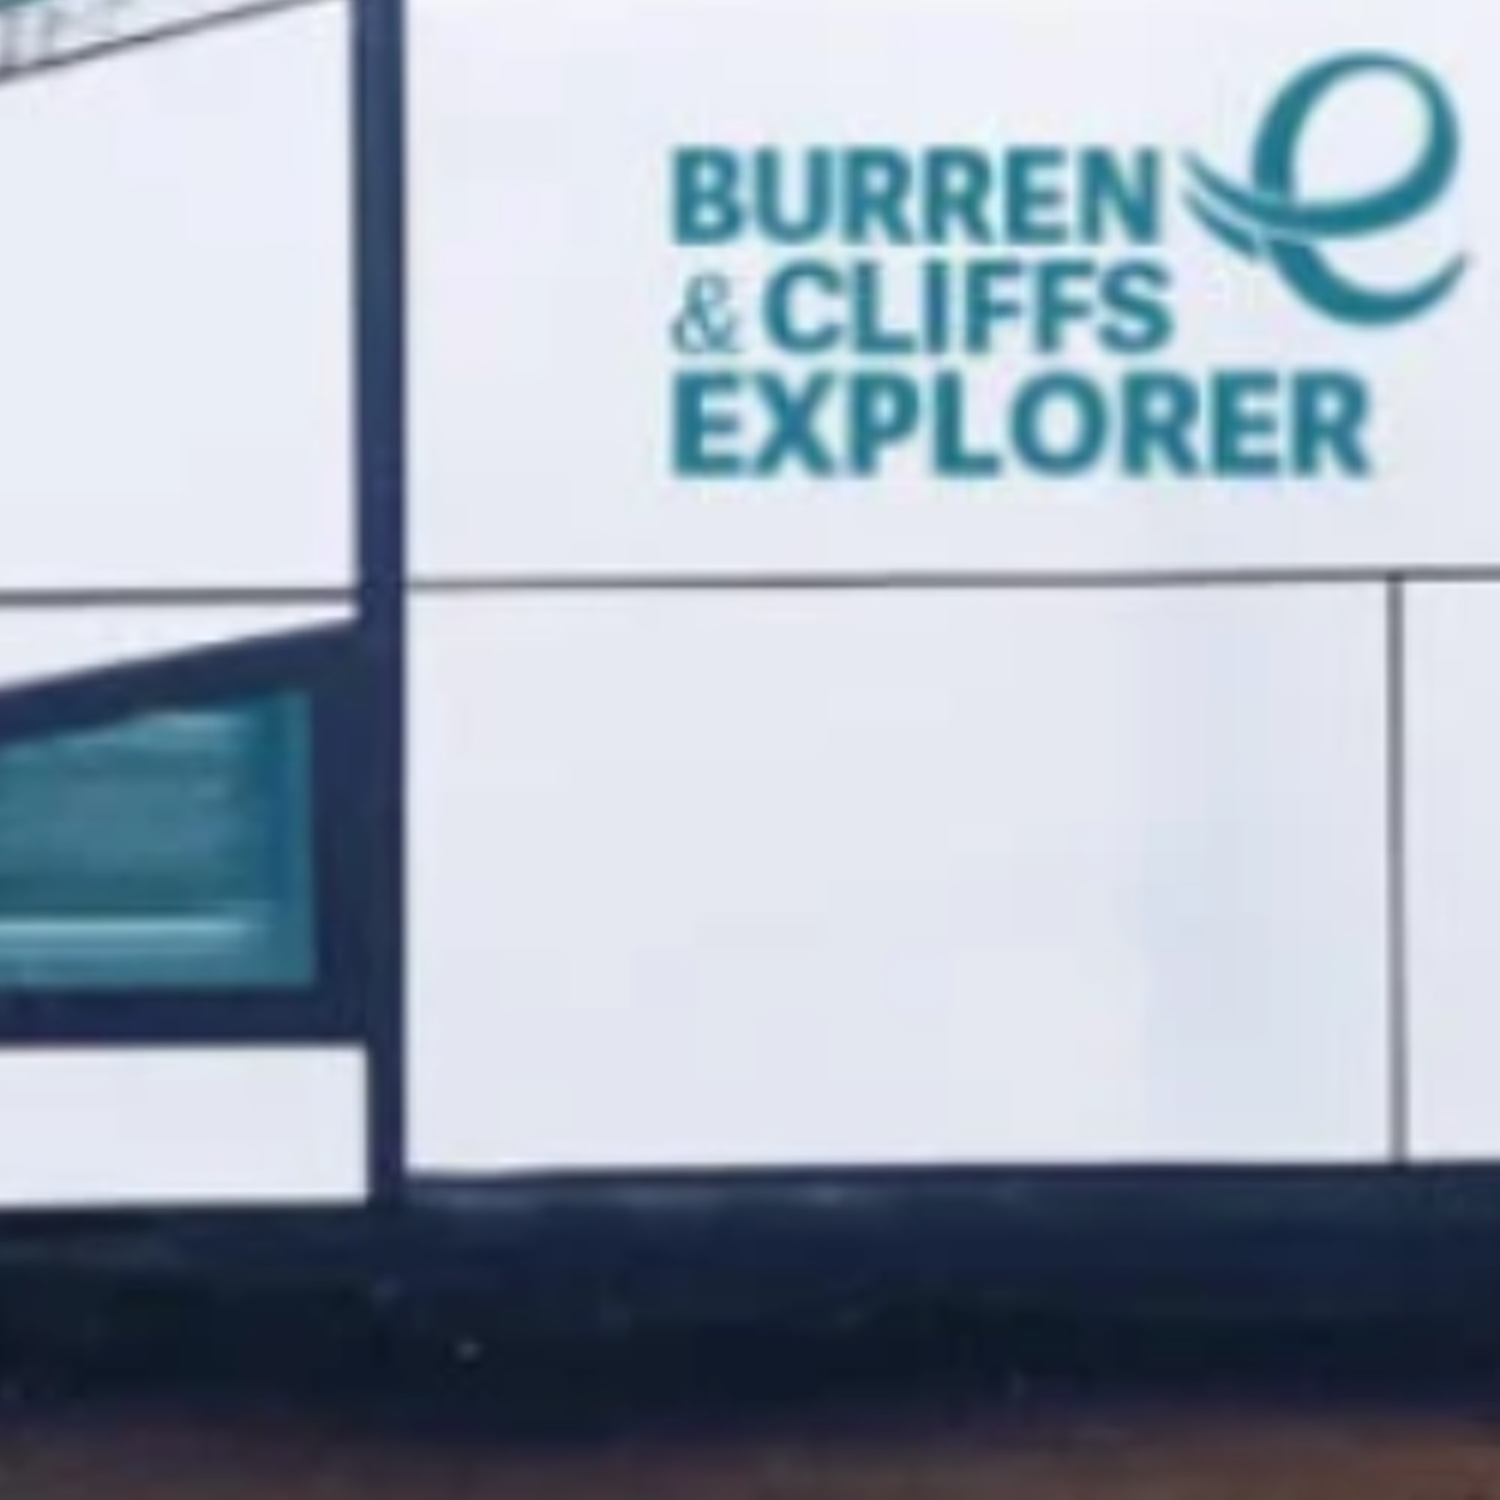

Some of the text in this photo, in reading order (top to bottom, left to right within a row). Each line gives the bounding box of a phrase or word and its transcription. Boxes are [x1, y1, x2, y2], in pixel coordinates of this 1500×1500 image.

[671, 145, 1162, 247] BURREN
[671, 257, 1175, 356] & CLIFFS
[671, 368, 1371, 479] EXPLORER
